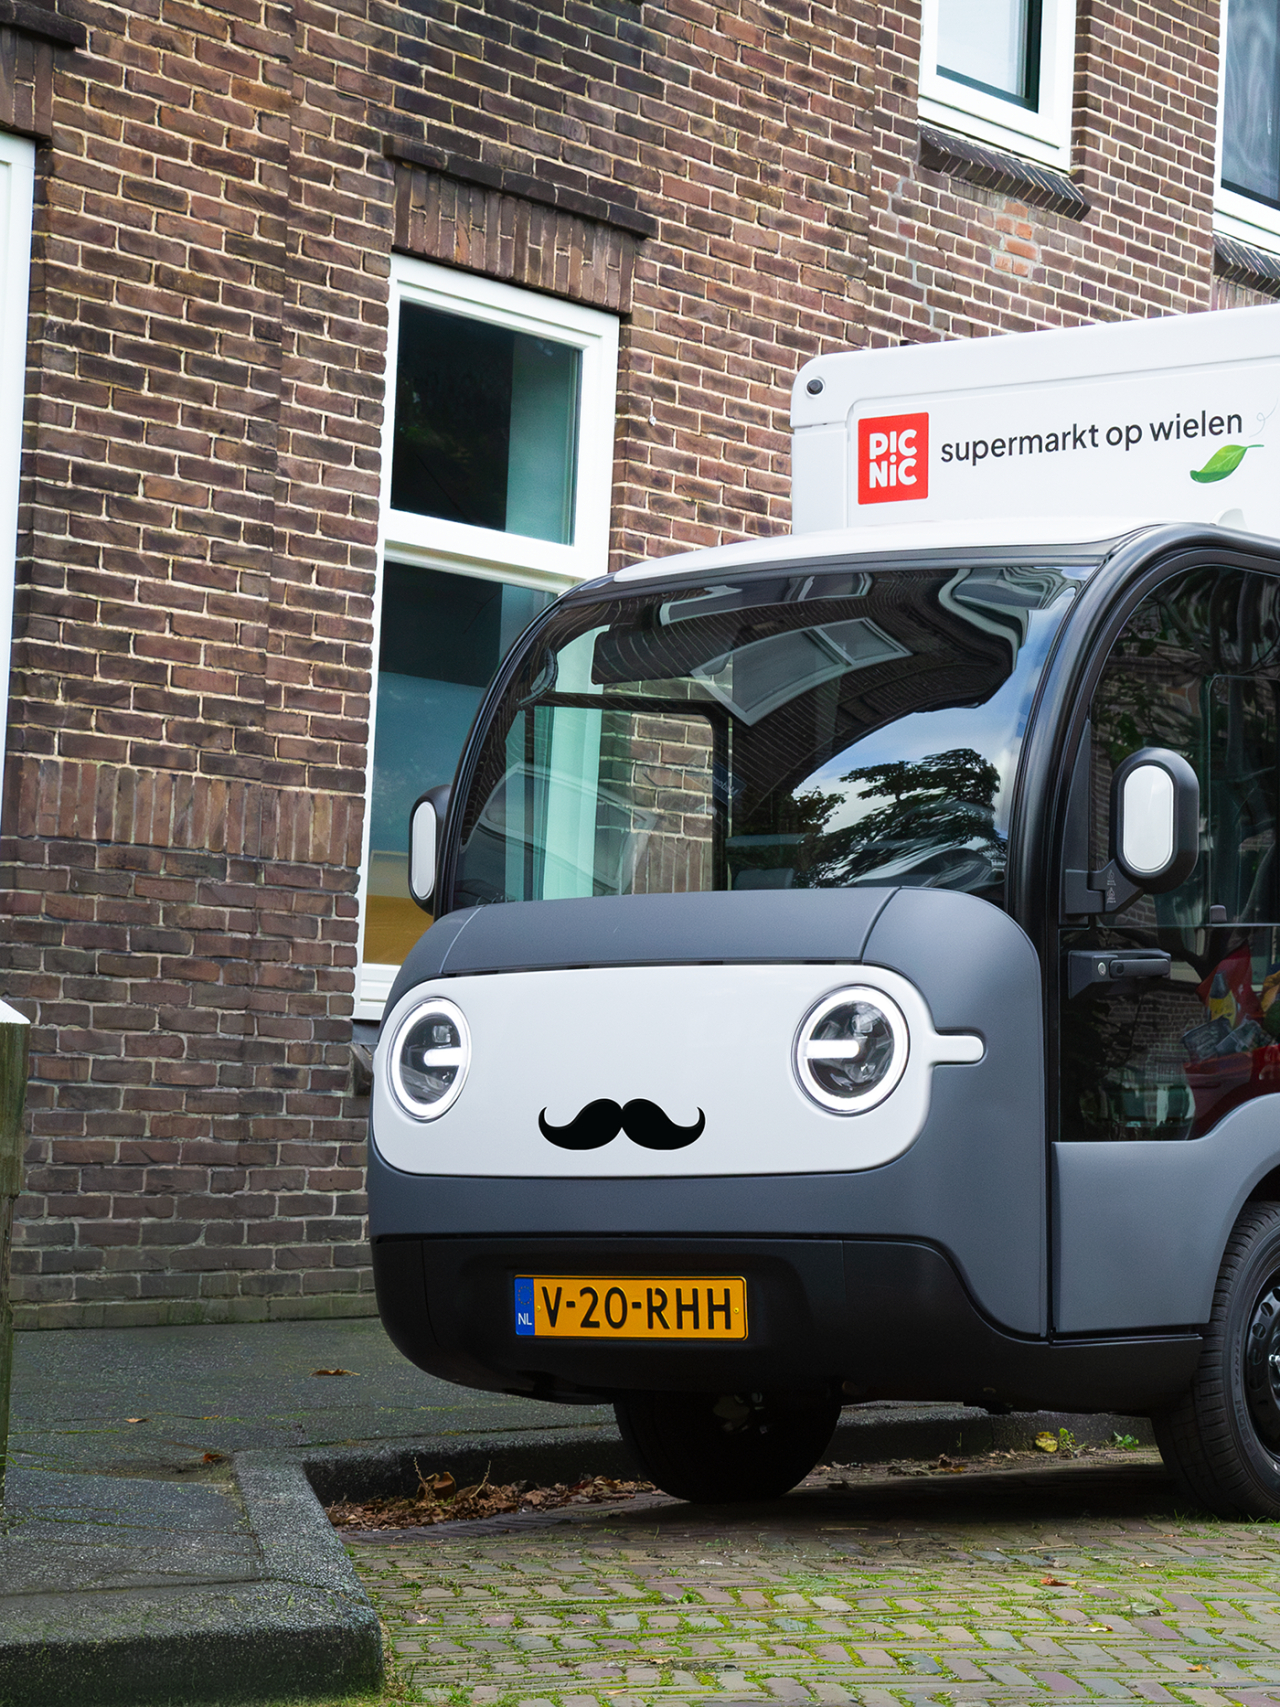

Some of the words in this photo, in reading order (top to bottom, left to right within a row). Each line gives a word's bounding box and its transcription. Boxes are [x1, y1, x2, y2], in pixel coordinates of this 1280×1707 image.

[869, 428, 918, 460] PIC
[940, 423, 1099, 467] supermarkt
[1105, 424, 1143, 452] op
[1149, 410, 1242, 442] wielen
[517, 1312, 533, 1326] NL
[541, 1286, 732, 1330] V-20-RHH
